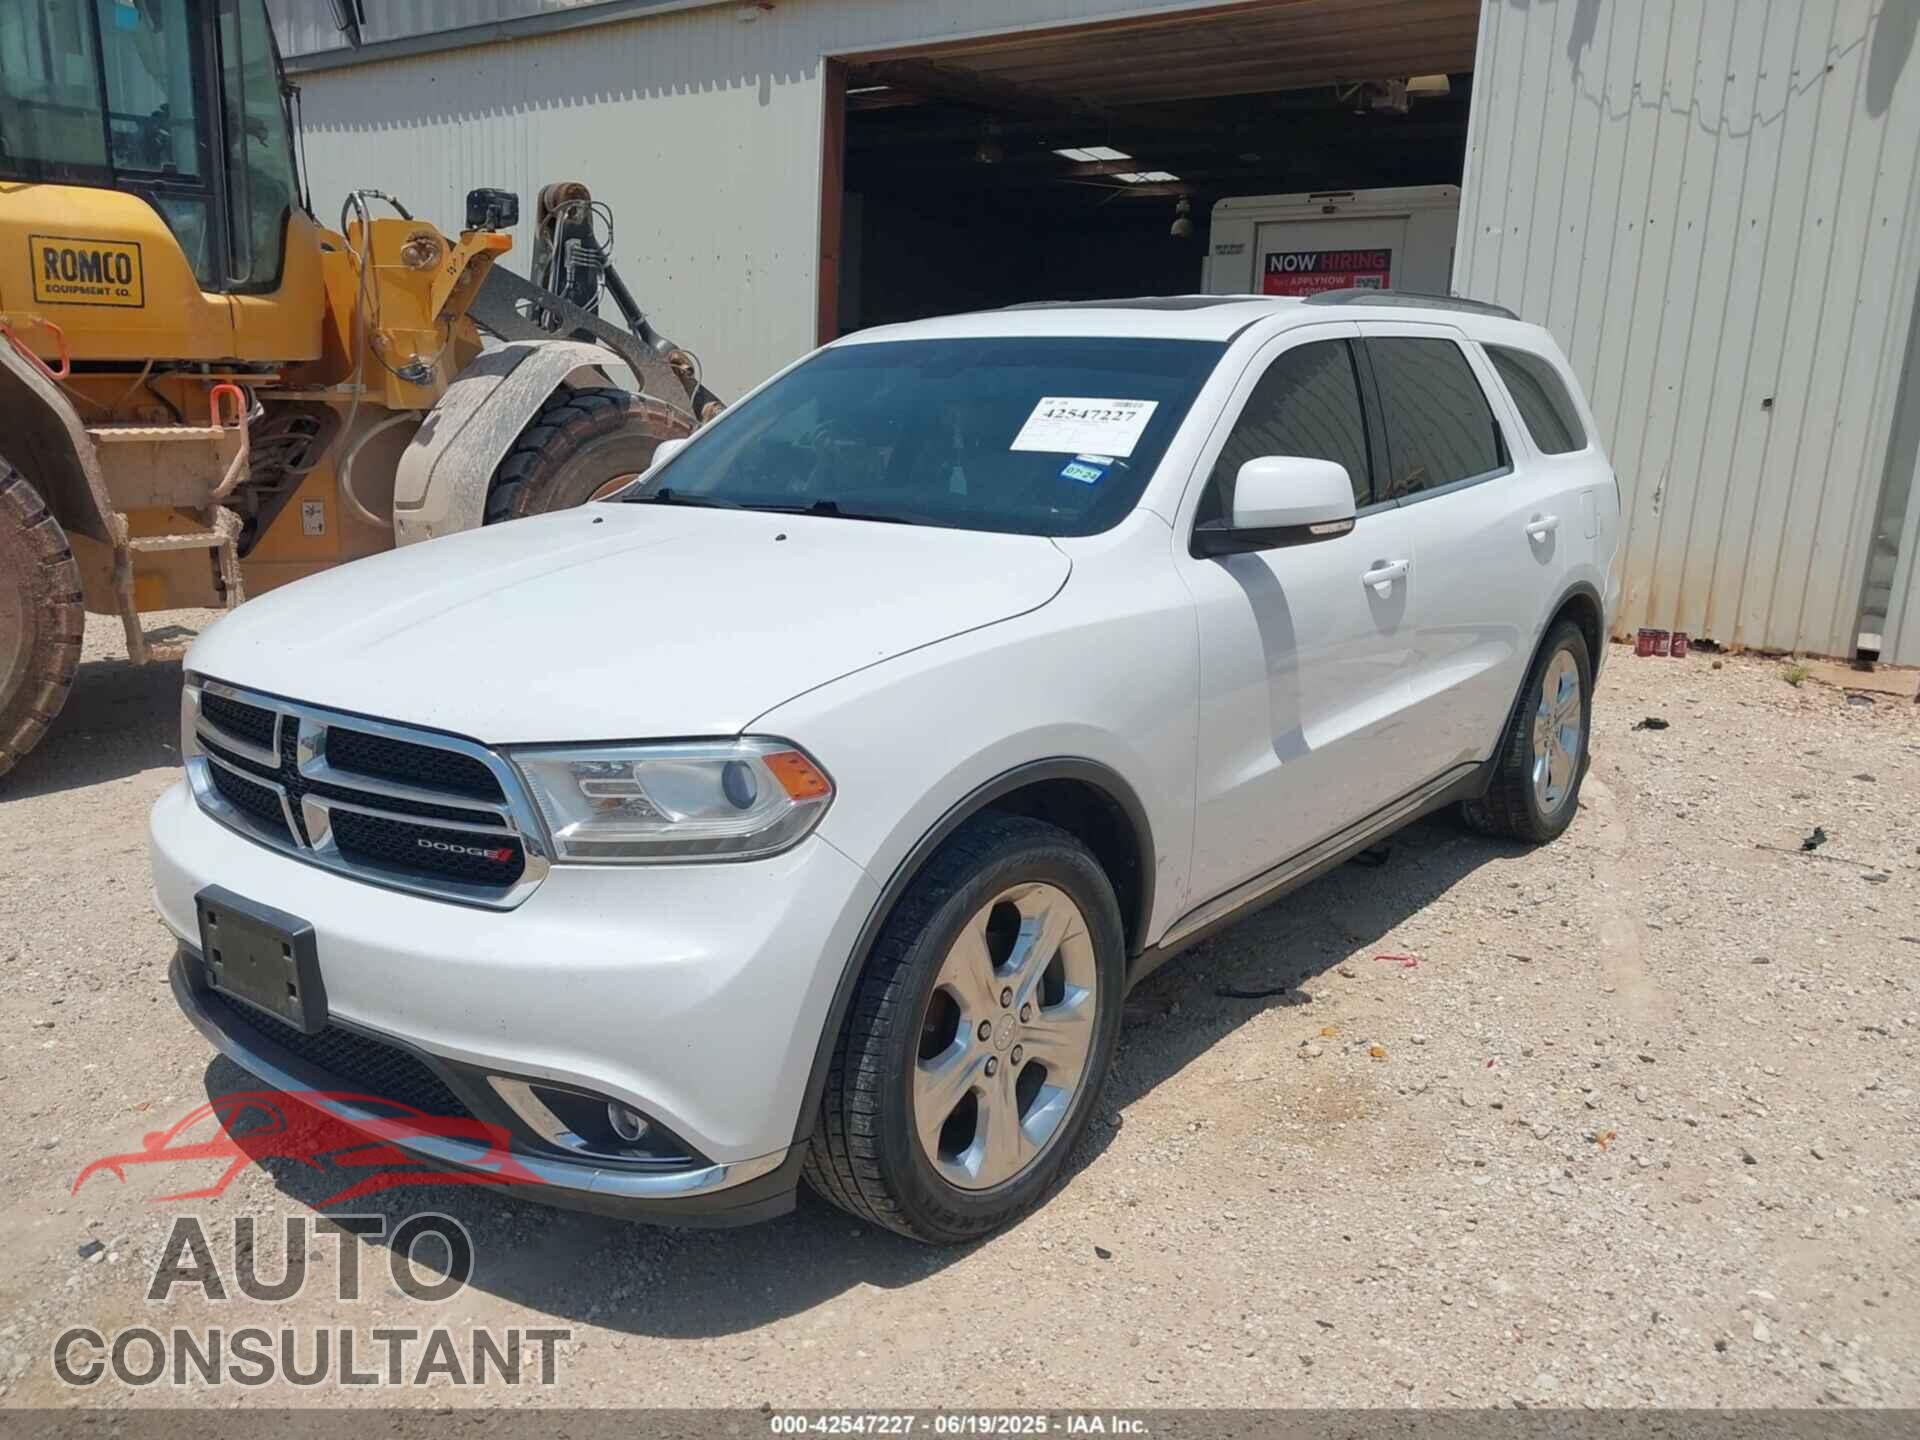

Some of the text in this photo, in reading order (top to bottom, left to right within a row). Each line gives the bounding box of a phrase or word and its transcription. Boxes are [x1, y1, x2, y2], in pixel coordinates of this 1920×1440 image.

[43, 247, 133, 285] ROMCO
[1270, 251, 1386, 272] NOW HIRING
[45, 283, 112, 296] EQUIPMENT
[1043, 407, 1137, 422] 42547227
[417, 839, 499, 860] DODGE
